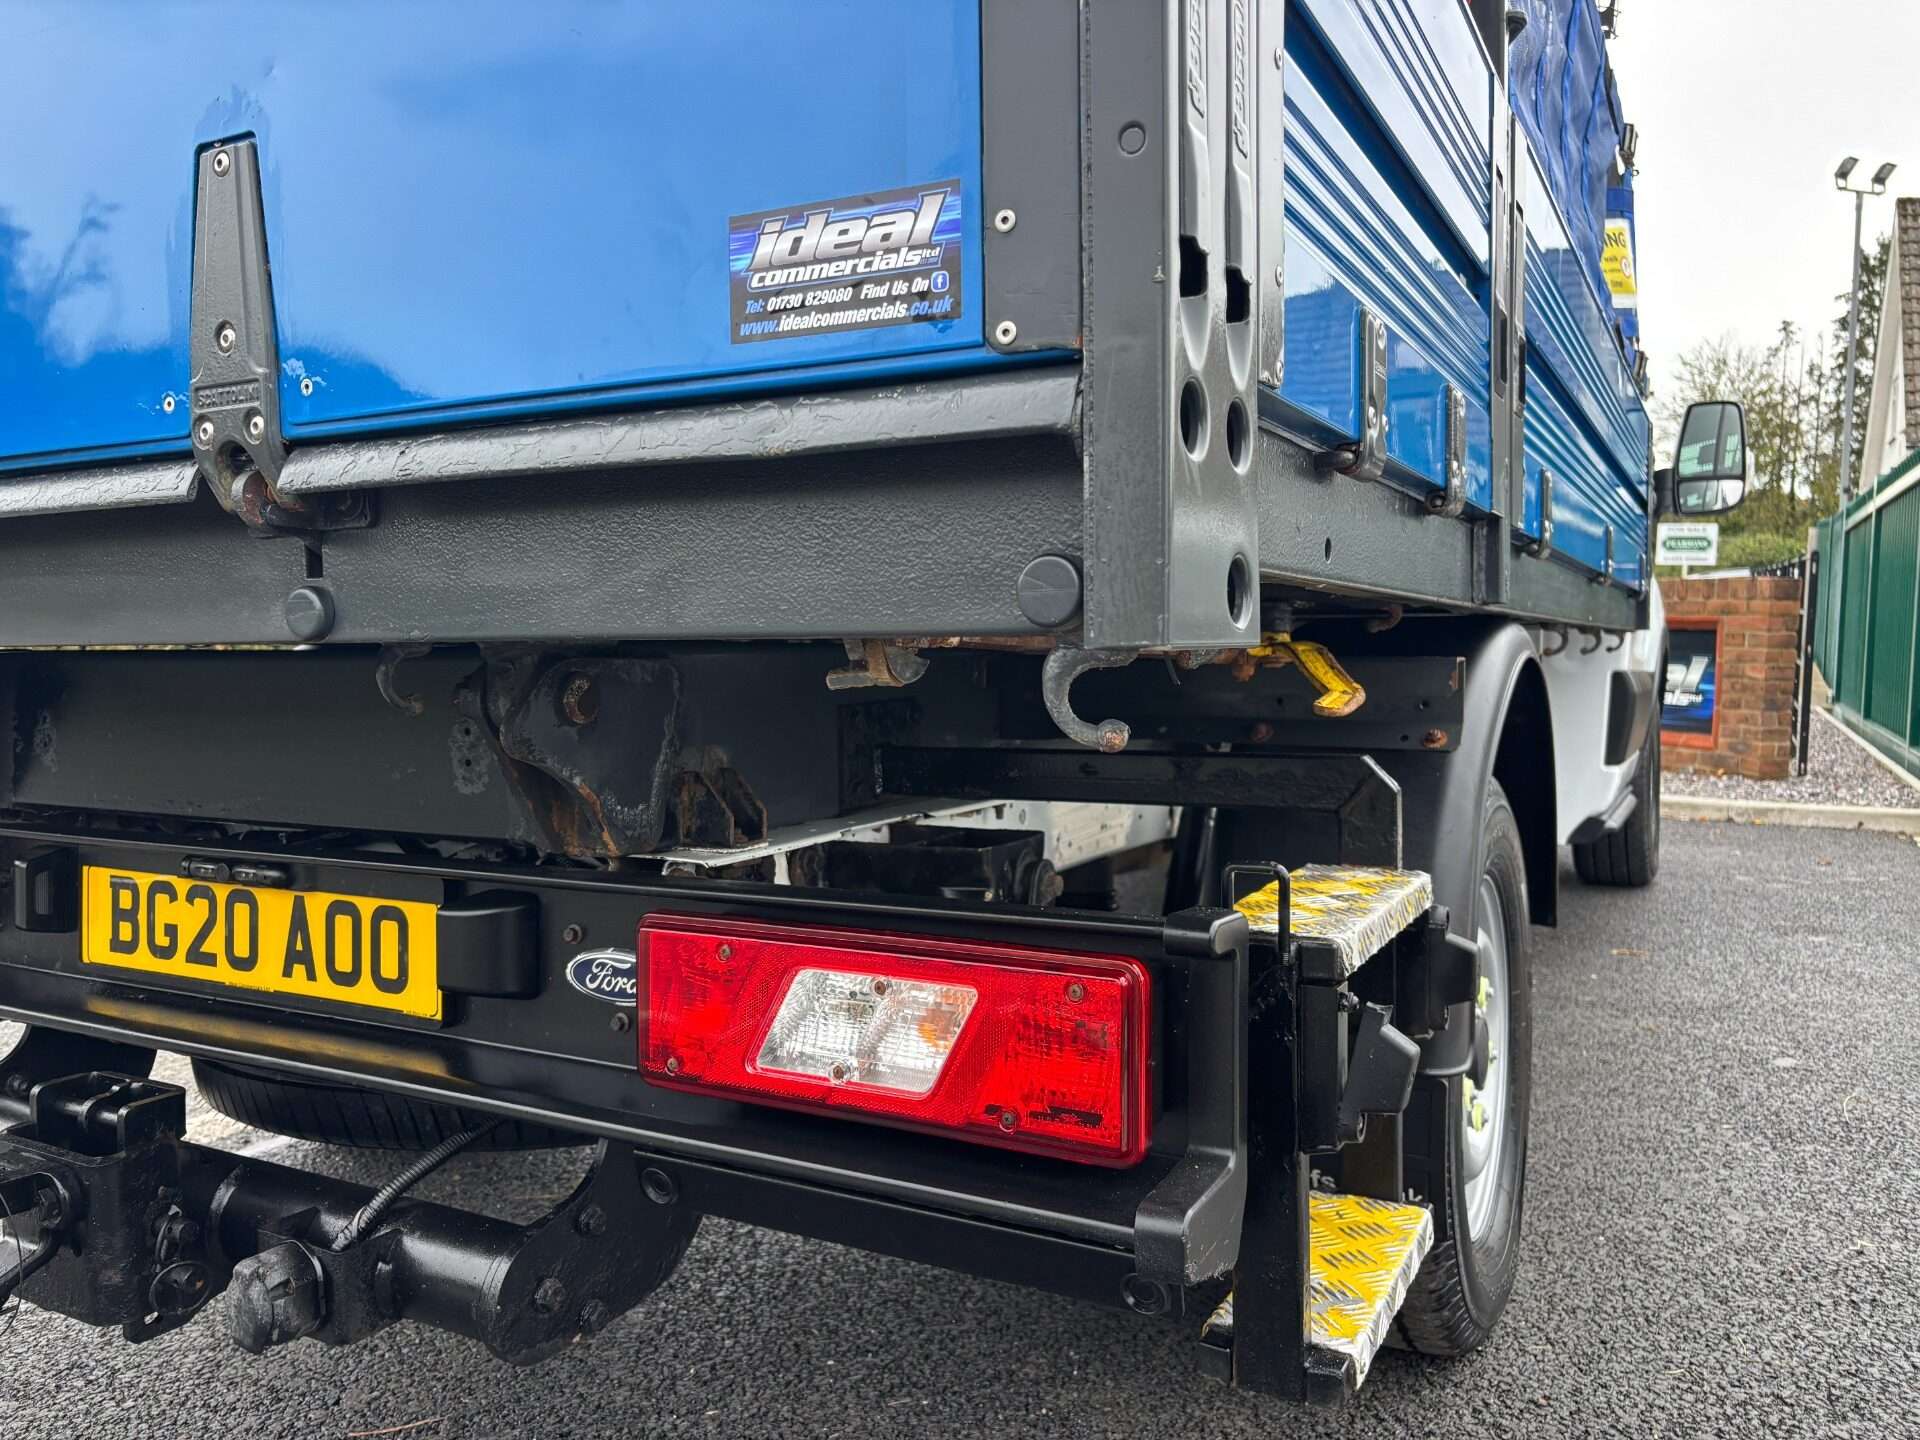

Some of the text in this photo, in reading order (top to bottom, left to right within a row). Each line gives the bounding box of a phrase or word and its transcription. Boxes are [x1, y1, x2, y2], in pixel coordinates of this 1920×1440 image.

[749, 190, 950, 271] ideal
[750, 247, 922, 289] commercials
[739, 294, 954, 337] www.idealcommercials.co.uk
[745, 298, 765, 314] Tel:
[766, 292, 803, 312] 01730
[804, 286, 853, 306] 829080
[860, 281, 890, 300] Find
[891, 279, 910, 296] Us
[911, 276, 930, 293] On
[109, 874, 260, 973] BG20
